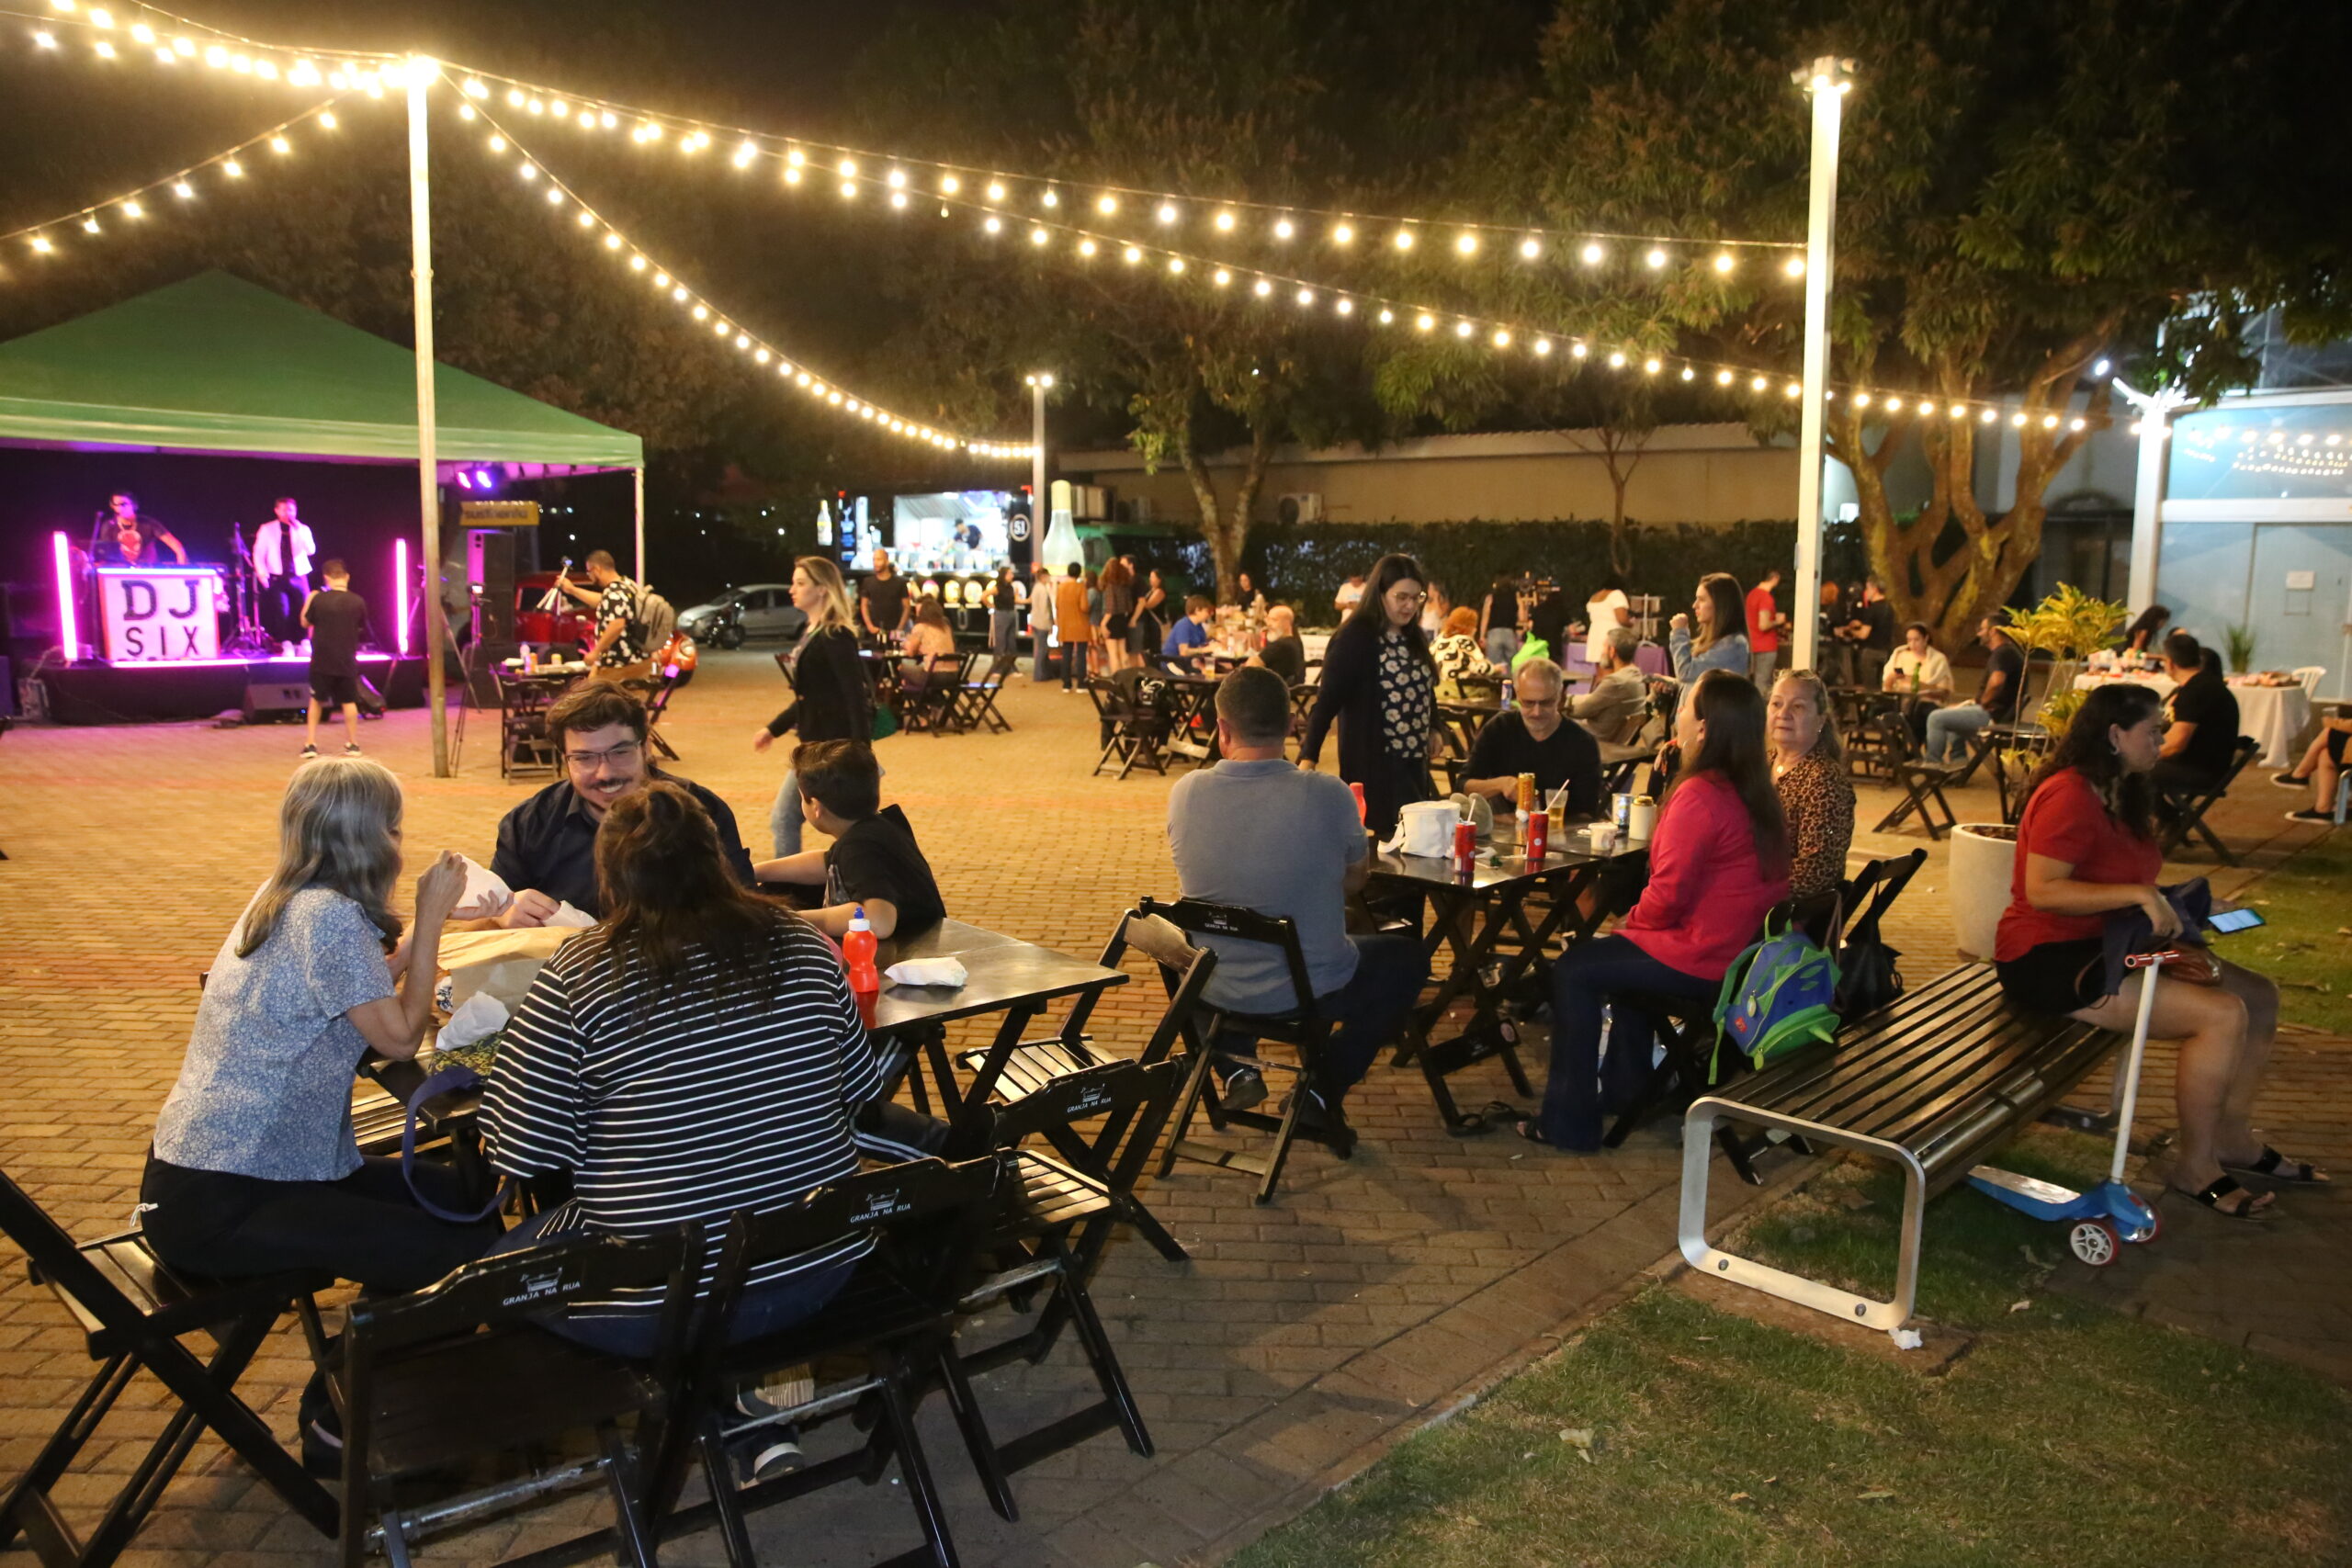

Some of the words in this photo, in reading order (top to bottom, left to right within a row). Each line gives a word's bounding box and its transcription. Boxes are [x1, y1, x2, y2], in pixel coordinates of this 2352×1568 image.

[1013, 520, 1025, 535] 51
[120, 580, 199, 621] DJ
[125, 626, 198, 657] SIX
[1067, 1102, 1088, 1113] GRANJA
[850, 1211, 879, 1224] GRANJA
[882, 1207, 893, 1215] NA
[896, 1202, 910, 1213] RUA
[503, 1291, 540, 1306] GRANJA
[544, 1287, 558, 1296] NA
[562, 1280, 581, 1292] RUA
